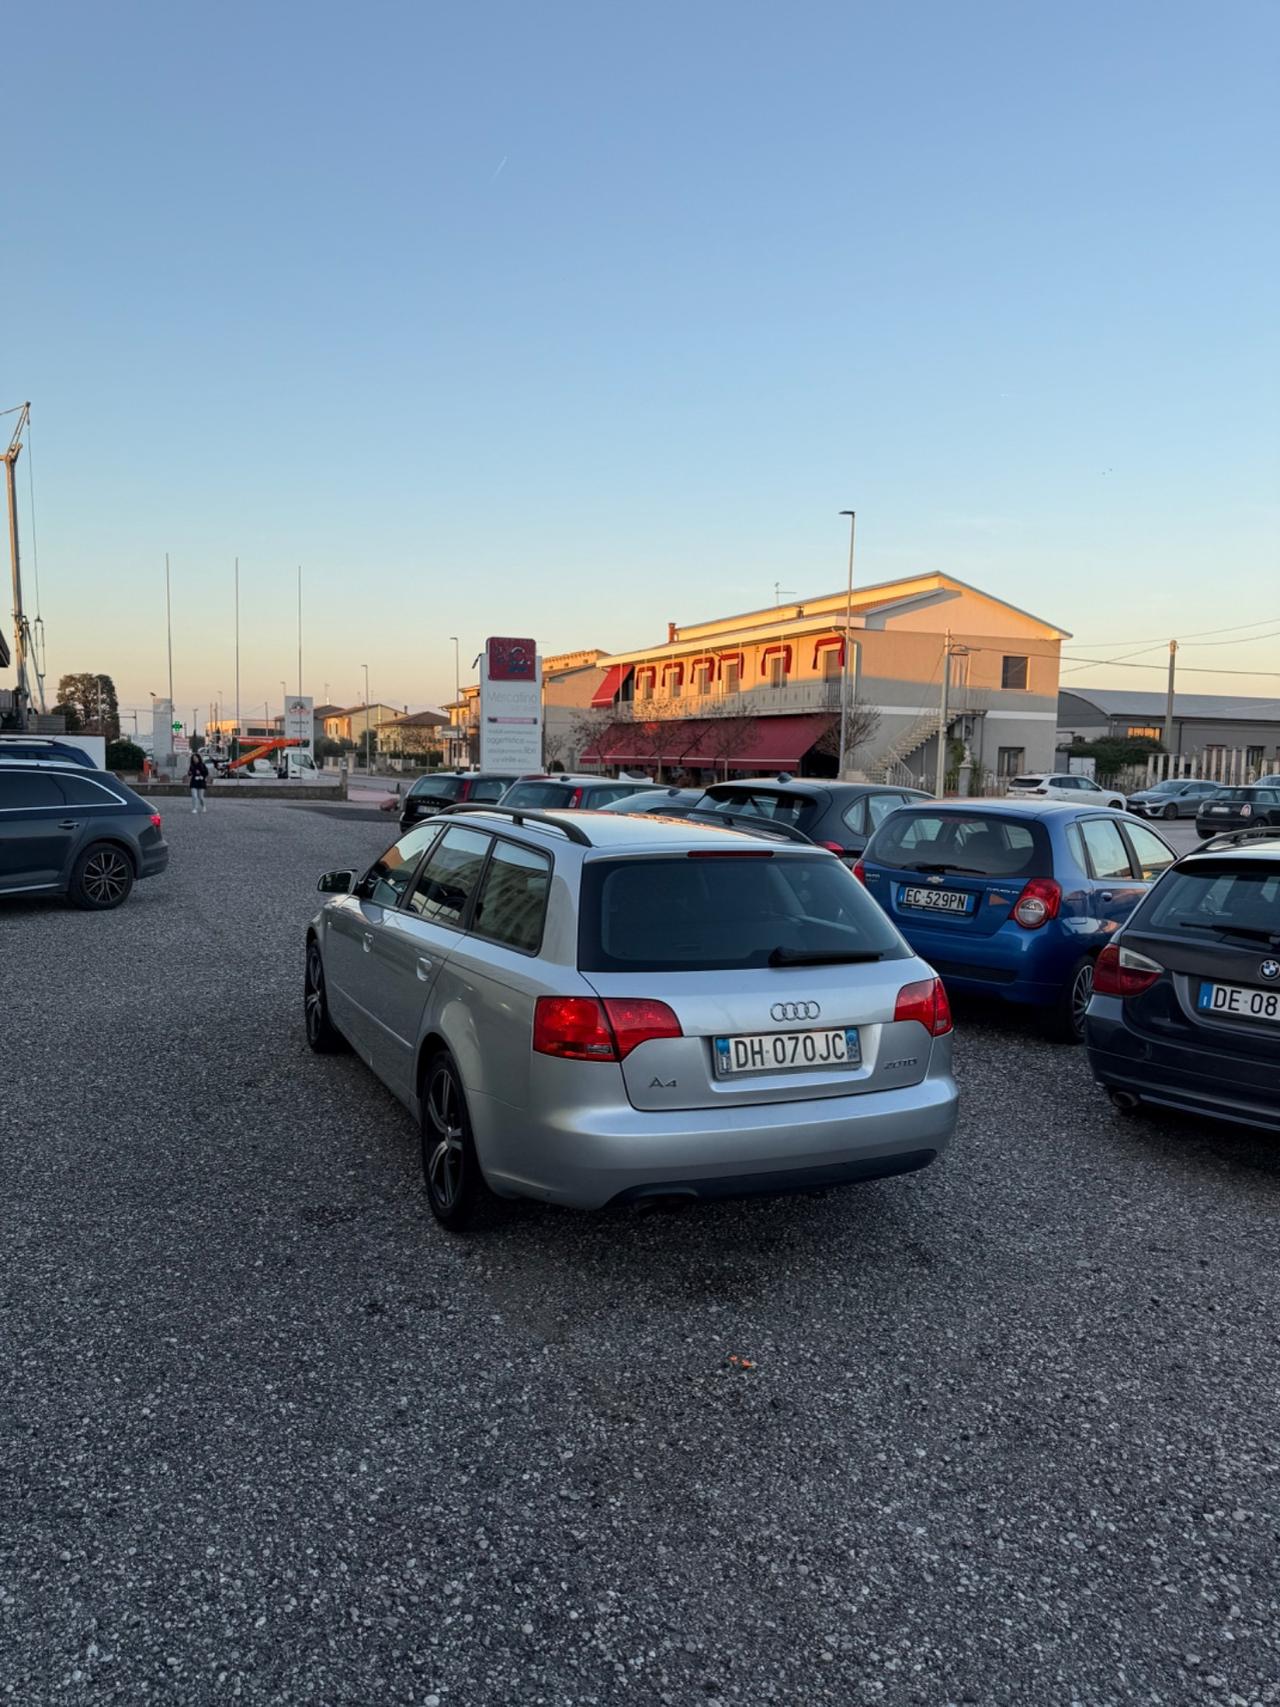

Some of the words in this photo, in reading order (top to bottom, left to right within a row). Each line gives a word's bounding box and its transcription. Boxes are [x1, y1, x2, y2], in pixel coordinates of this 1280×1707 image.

[487, 692, 538, 704] Mercatino
[905, 889, 922, 903] EC
[926, 893, 967, 910] 529PN
[1213, 986, 1242, 1011] DE
[735, 1037, 765, 1069] DH
[772, 1033, 845, 1065] 070JC
[648, 1076, 677, 1088] A4
